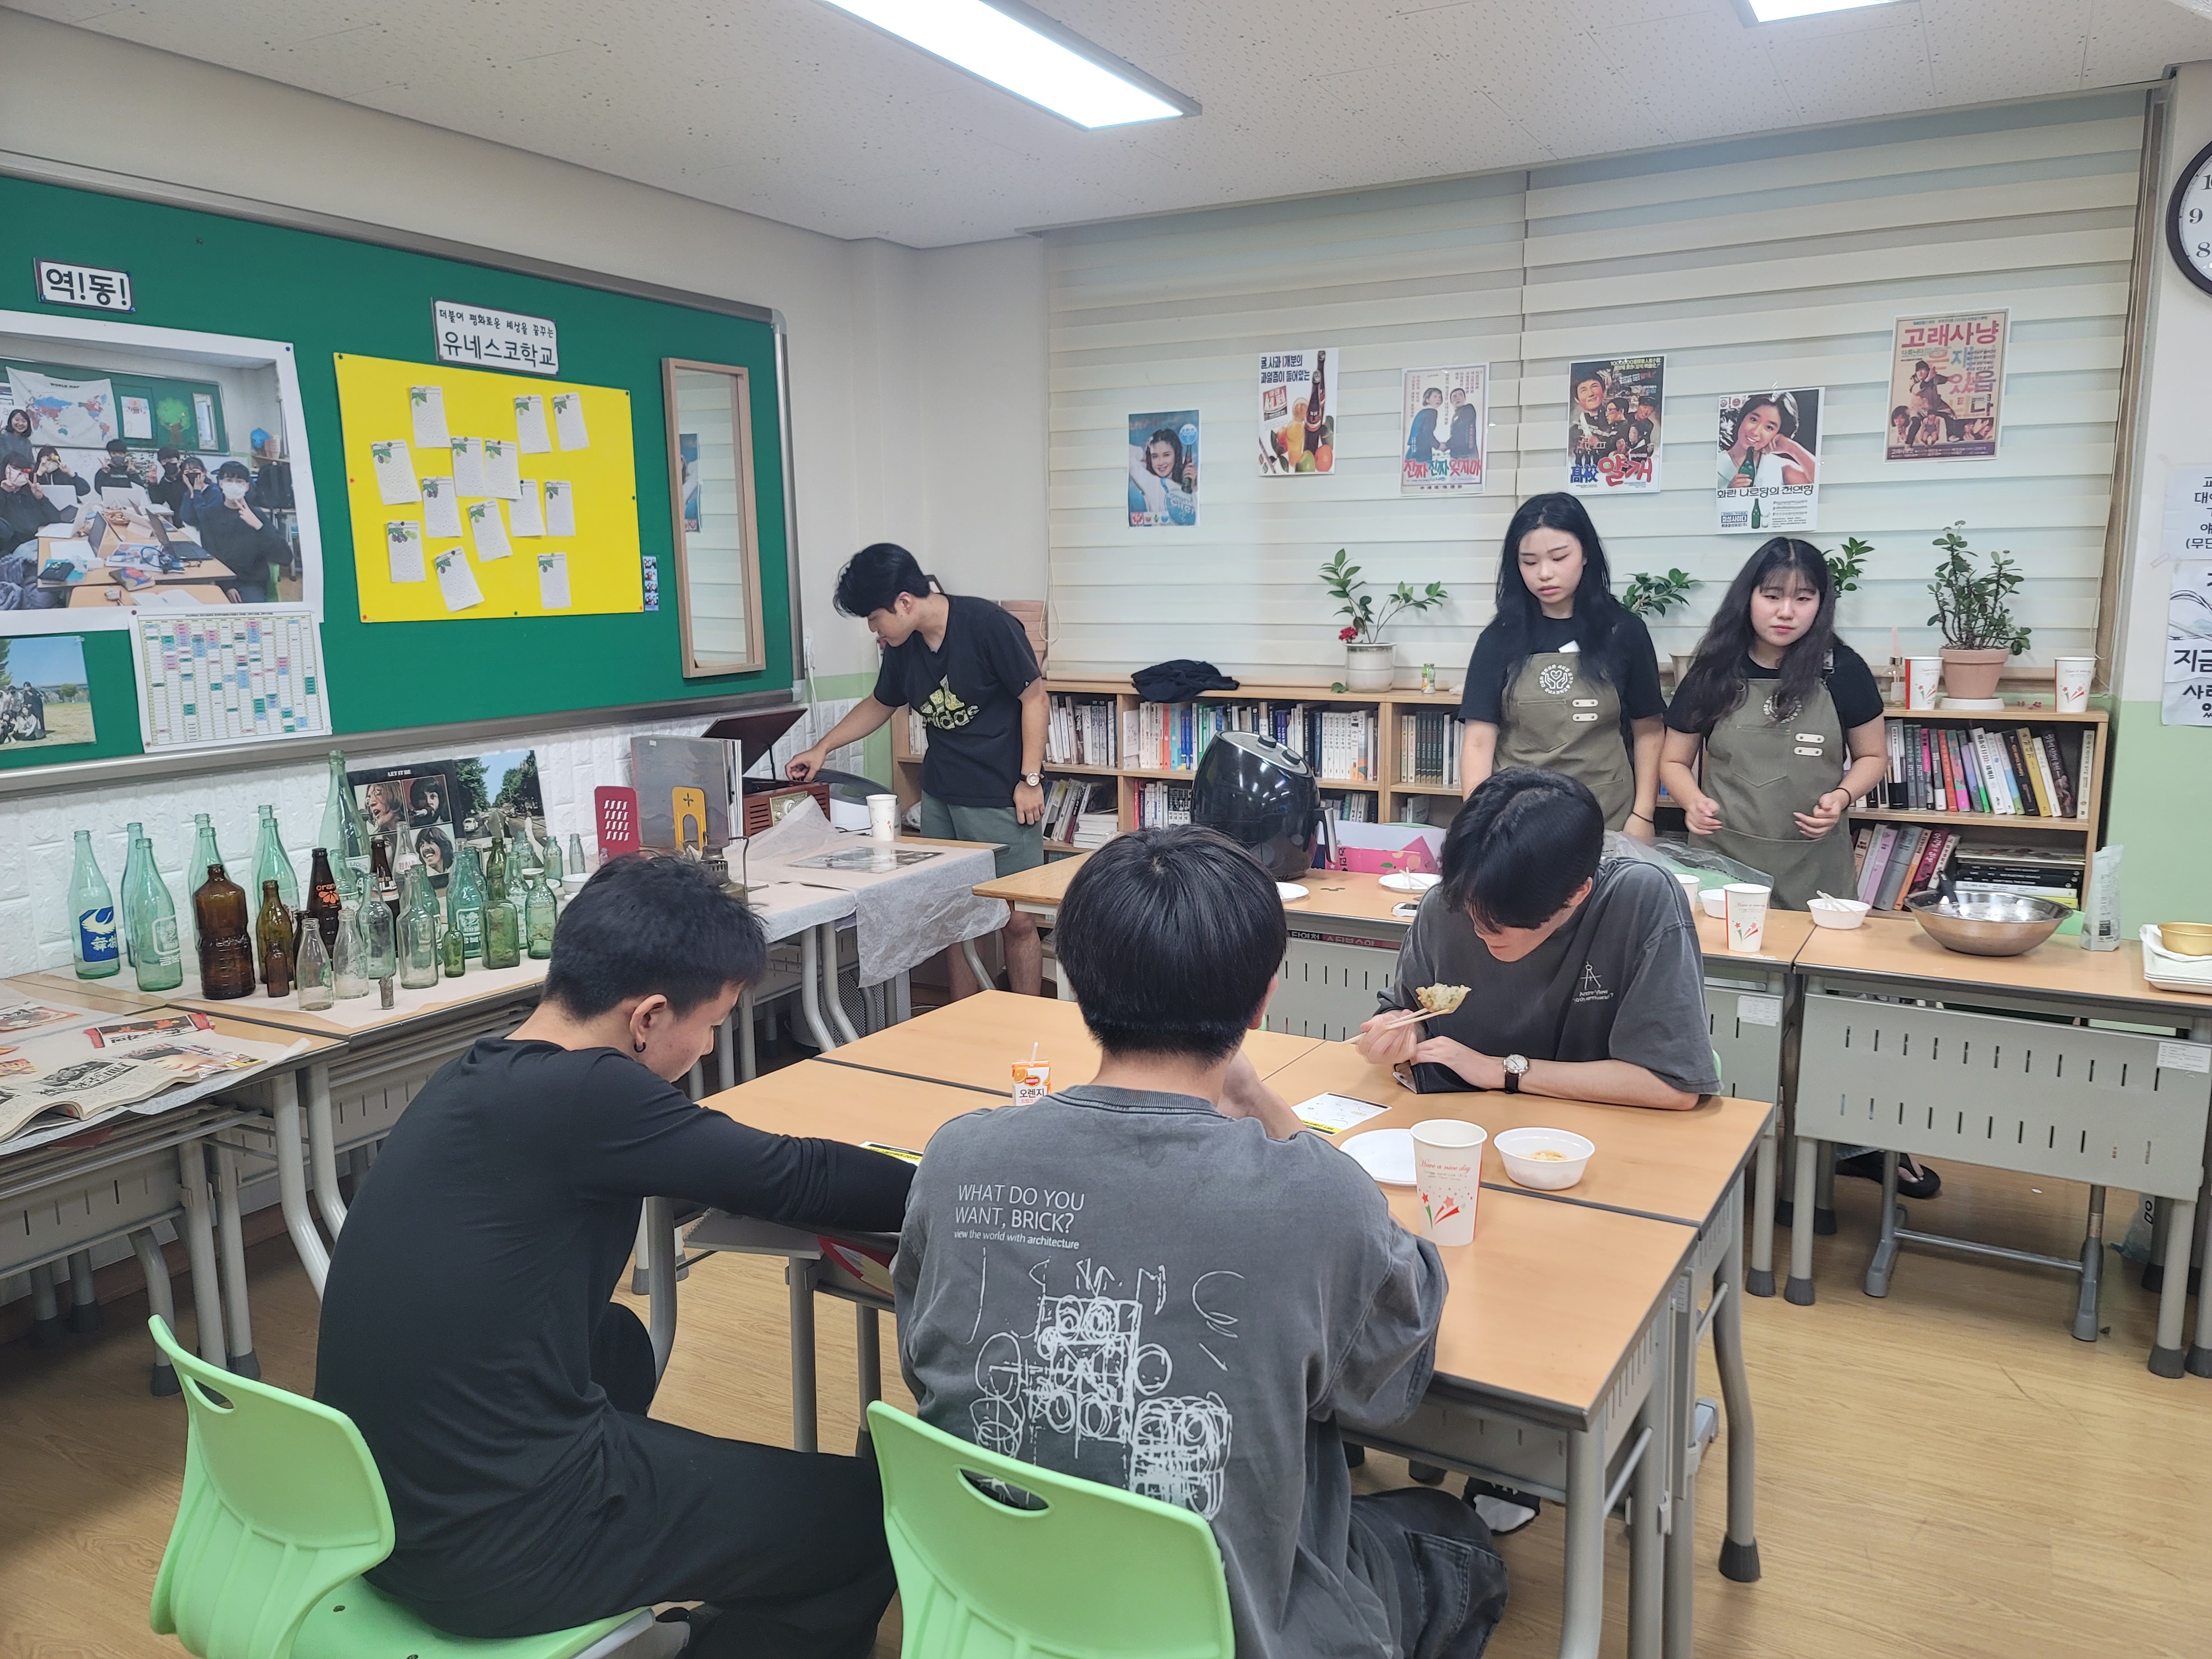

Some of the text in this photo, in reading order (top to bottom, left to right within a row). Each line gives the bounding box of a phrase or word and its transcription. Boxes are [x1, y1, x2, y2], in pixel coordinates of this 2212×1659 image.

[2200, 174, 2212, 190] 1
[2189, 208, 2203, 224] 9
[2196, 242, 2211, 258] 8
[46, 268, 127, 306] 역!동!
[440, 309, 464, 323] 더불어
[469, 314, 500, 329] 평화로운
[533, 324, 554, 338] 꿈꾸는
[1901, 320, 1999, 348] 고래사냥
[443, 331, 556, 368] 유네스코학교
[1261, 370, 1310, 383] 과일즙이 들어있는
[1404, 458, 1481, 478] 진짜 진짜 잊지마
[1571, 465, 1599, 483] 高校
[1598, 455, 1652, 487] 얄개
[1717, 488, 1736, 498] 화란
[1740, 486, 1780, 498] 나르당의
[349, 862, 368, 872] LIQUOR
[1019, 1088, 1045, 1098] 오렌지
[1419, 1157, 1436, 1168] Have
[1459, 1164, 1471, 1174] day
[959, 1184, 1084, 1211] WHAT DO YOU
[956, 1206, 1074, 1234] WANT, BRICK?
[954, 1229, 1080, 1250] view the world with architecture
